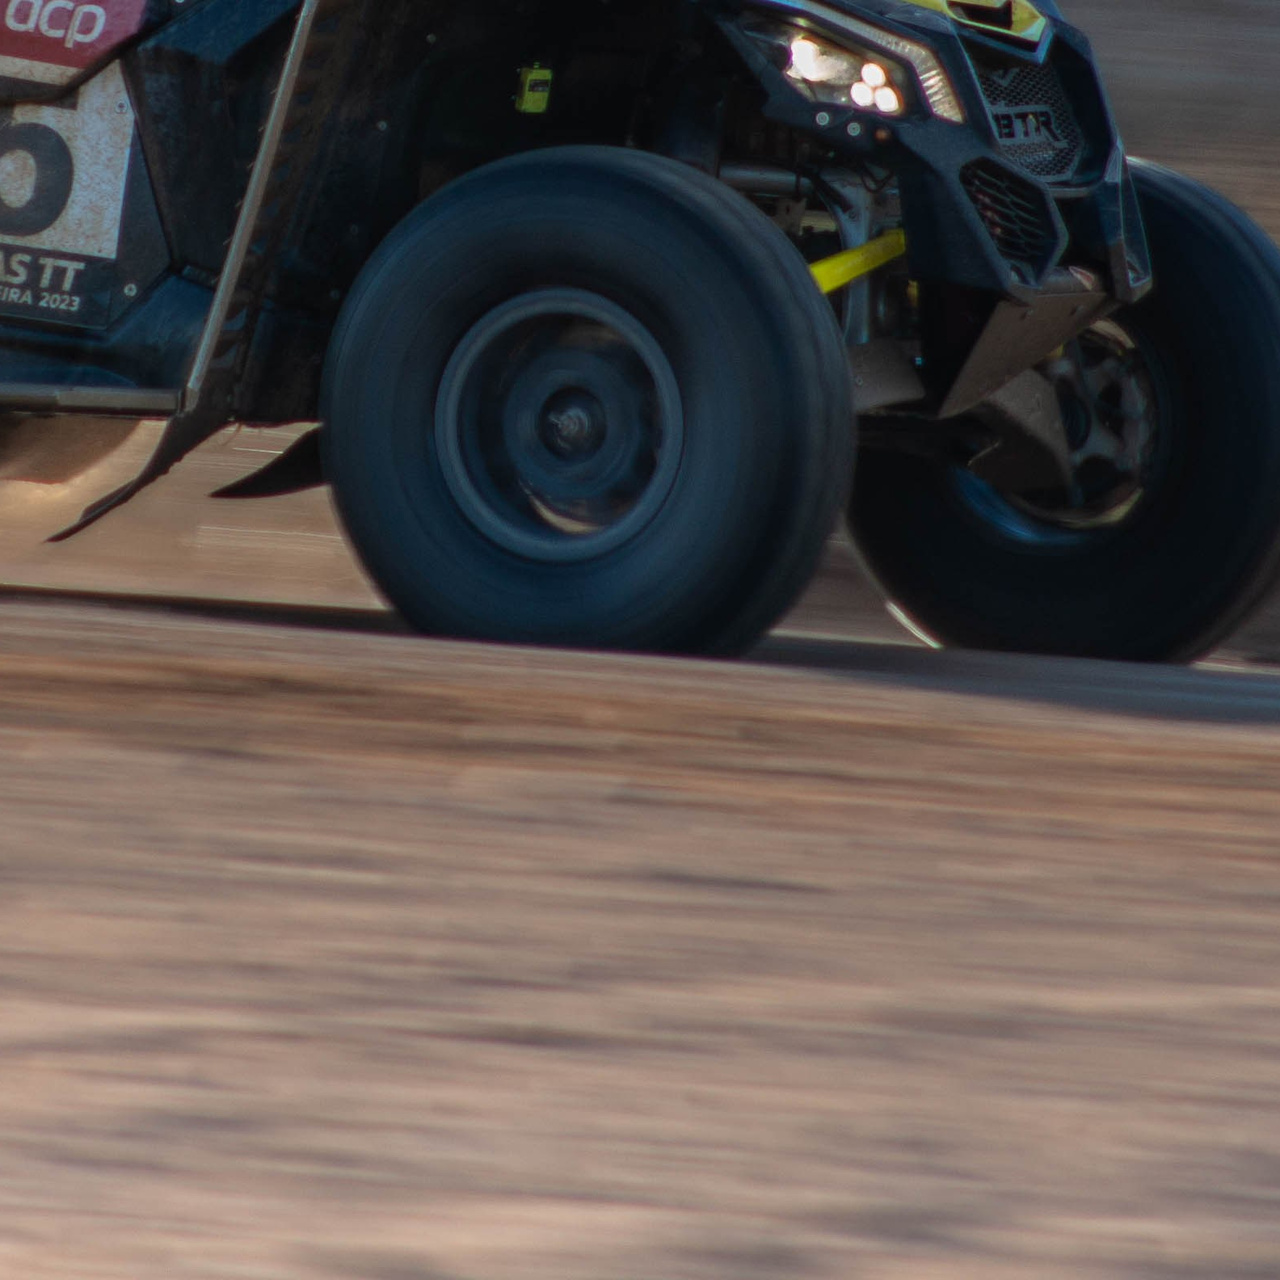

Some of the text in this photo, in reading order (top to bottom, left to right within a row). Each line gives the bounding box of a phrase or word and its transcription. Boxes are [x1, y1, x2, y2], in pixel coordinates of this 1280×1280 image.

[994, 111, 1062, 141] BTR
[38, 256, 86, 292] TT
[38, 292, 81, 312] 2023
